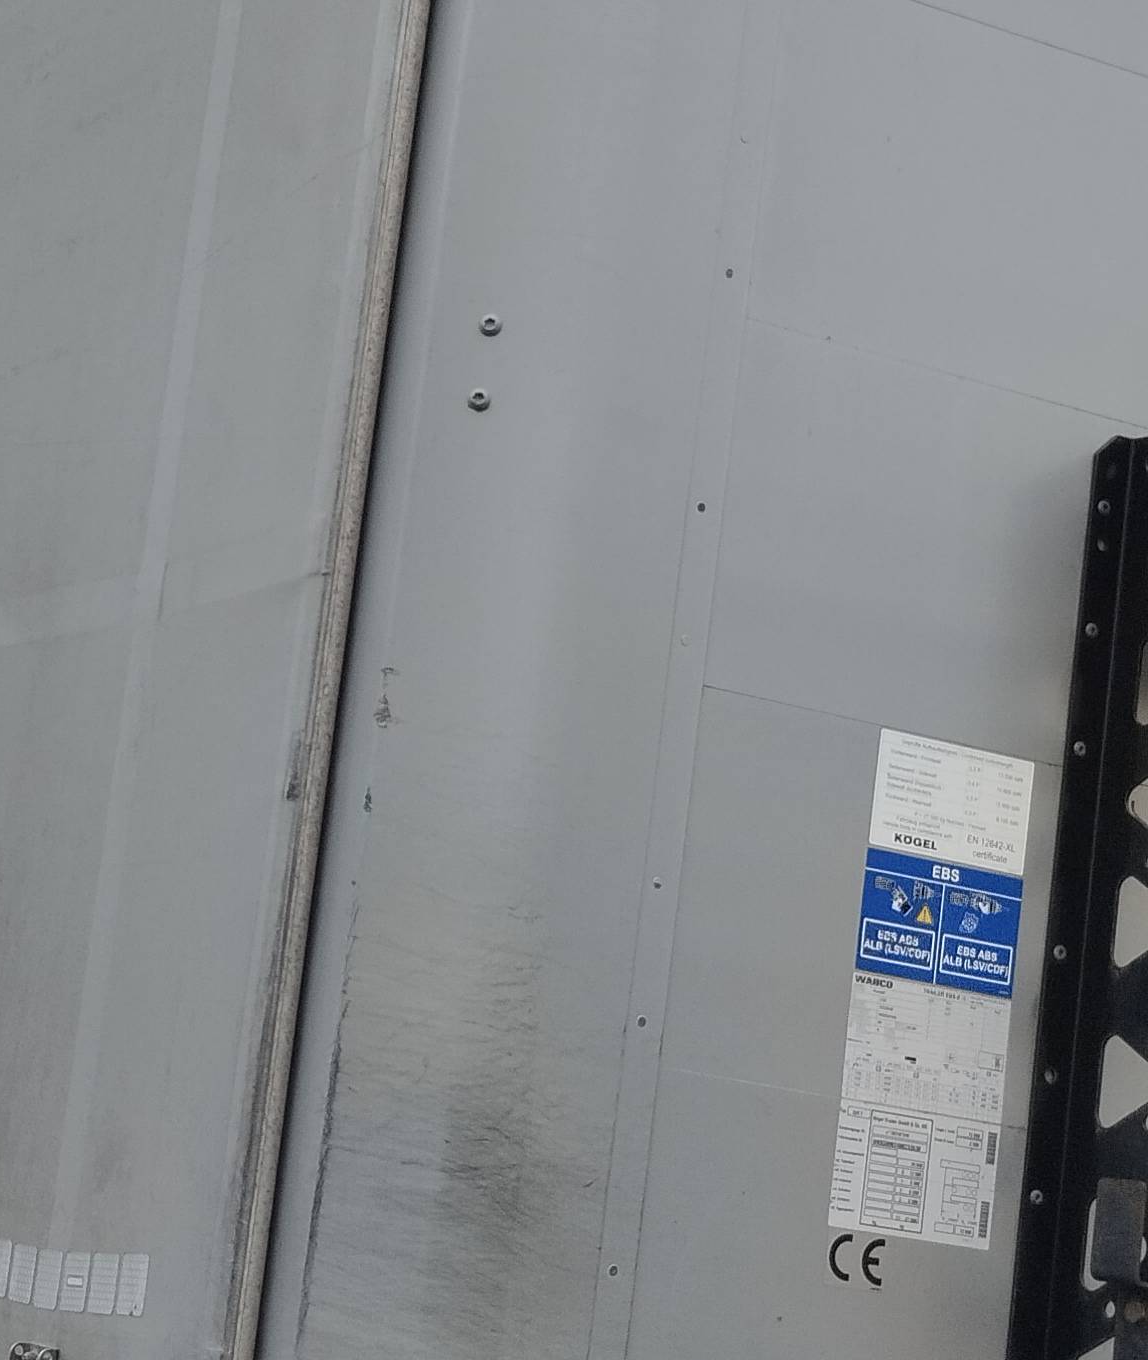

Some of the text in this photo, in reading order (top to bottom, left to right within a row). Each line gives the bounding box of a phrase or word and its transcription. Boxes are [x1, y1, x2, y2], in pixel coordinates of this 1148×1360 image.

[932, 865, 960, 882] EBS
[943, 954, 962, 966] ALB
[956, 945, 997, 961] EBS ABS
